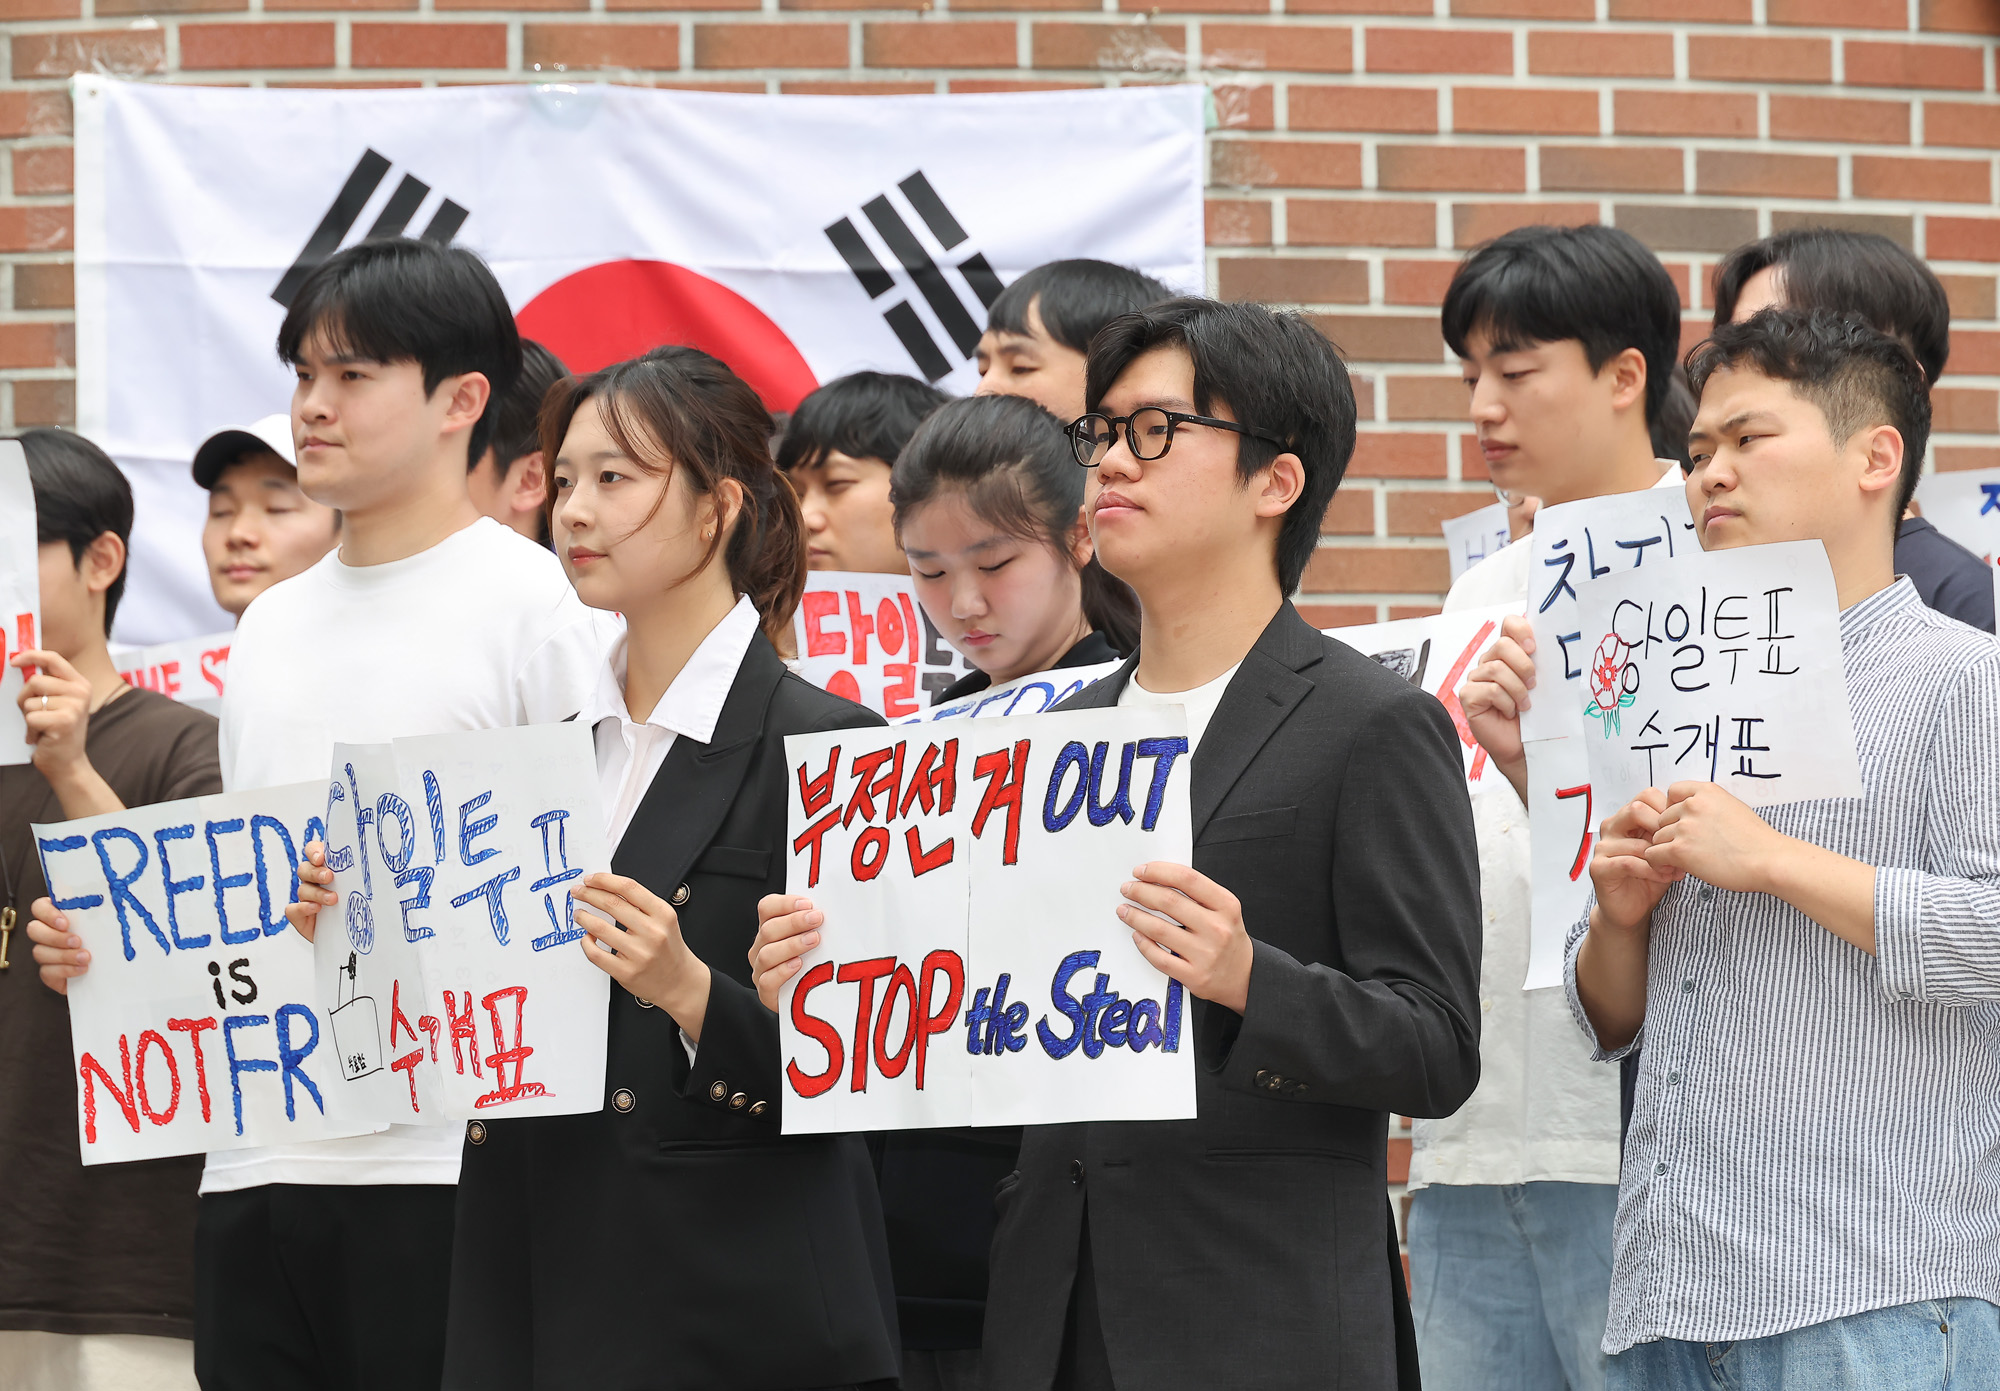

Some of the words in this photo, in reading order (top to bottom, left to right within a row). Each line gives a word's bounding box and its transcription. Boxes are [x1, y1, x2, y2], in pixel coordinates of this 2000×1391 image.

[1612, 587, 1800, 695] 당일투표
[793, 738, 1031, 888] 부정선거
[1043, 737, 1188, 832] OUT
[1630, 710, 1782, 787] 수개표
[324, 763, 590, 955] 당일투표
[208, 958, 258, 1010] is
[390, 979, 556, 1113] 수개표
[786, 949, 966, 1099] STOP
[965, 973, 1030, 1056] the
[1036, 926, 1184, 1060] Steal
[80, 1017, 217, 1144] NOT
